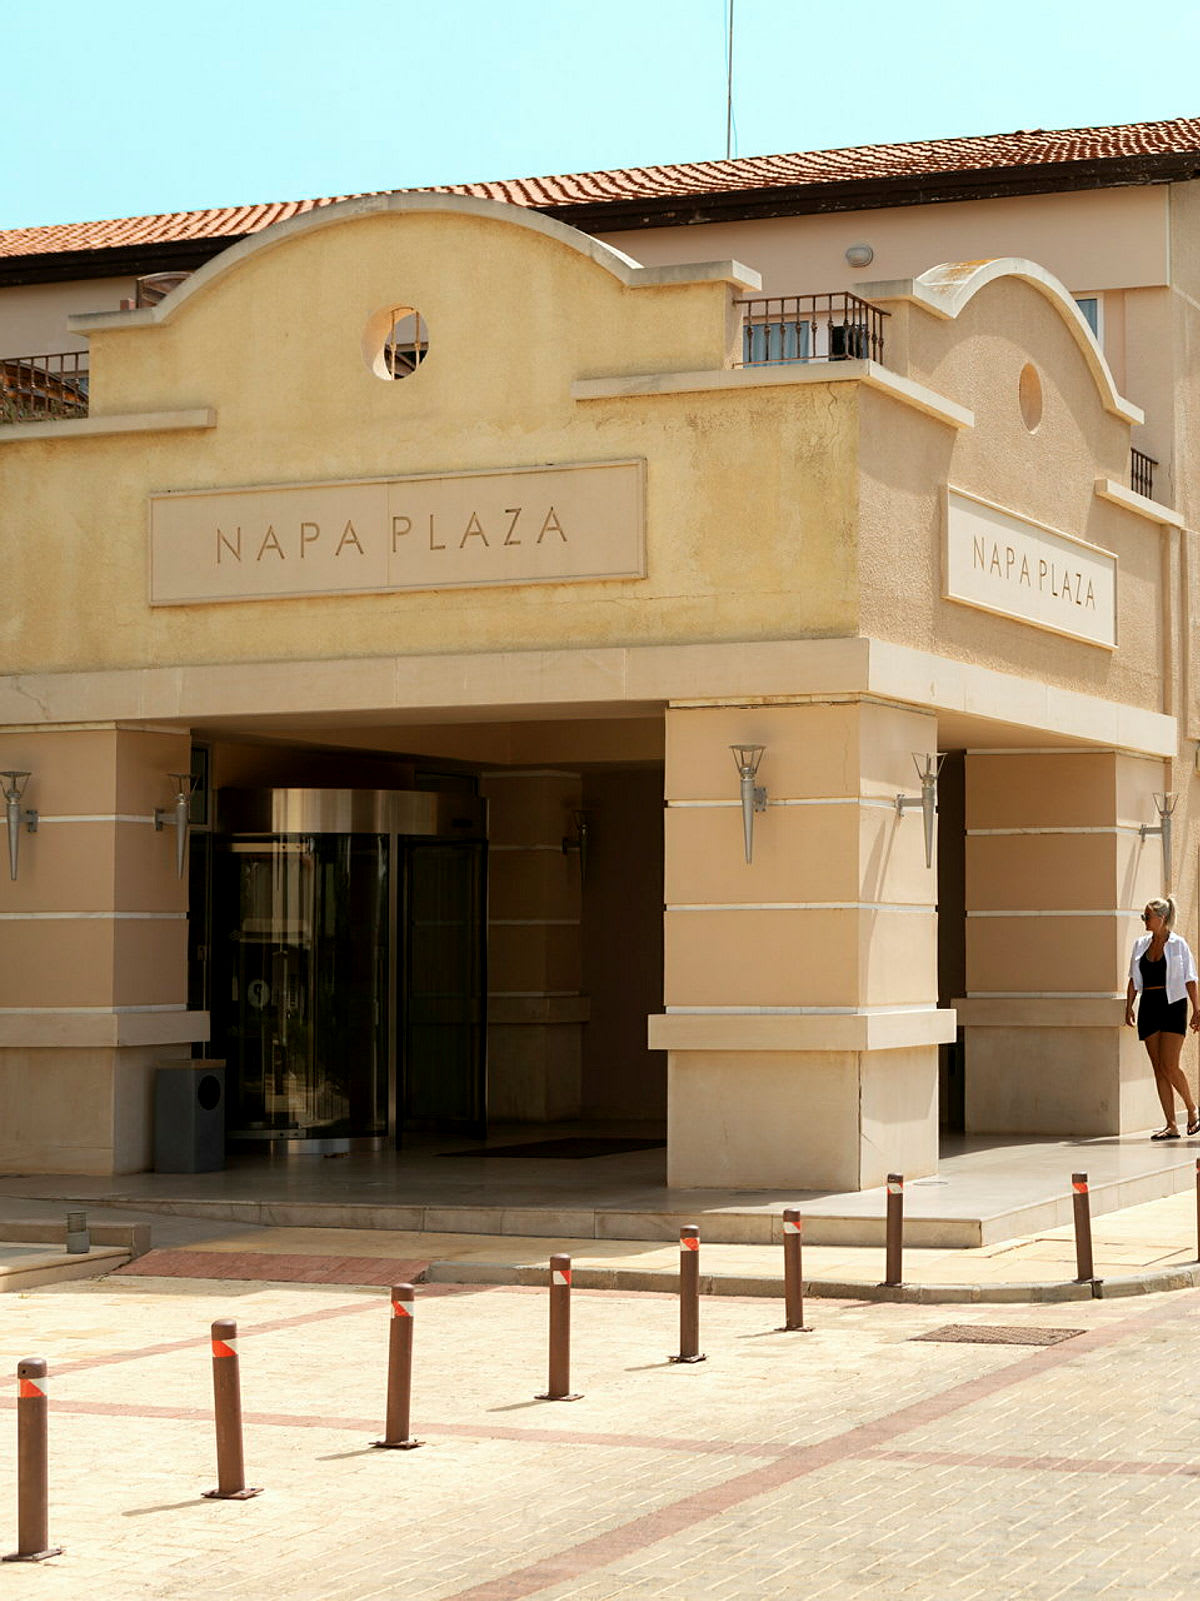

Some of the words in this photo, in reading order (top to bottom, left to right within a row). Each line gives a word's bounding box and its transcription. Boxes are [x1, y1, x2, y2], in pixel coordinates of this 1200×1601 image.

[215, 520, 366, 564] NAPA
[391, 506, 569, 553] PLAZA
[972, 535, 1031, 587] NAPA
[1038, 559, 1096, 609] PLAZA
